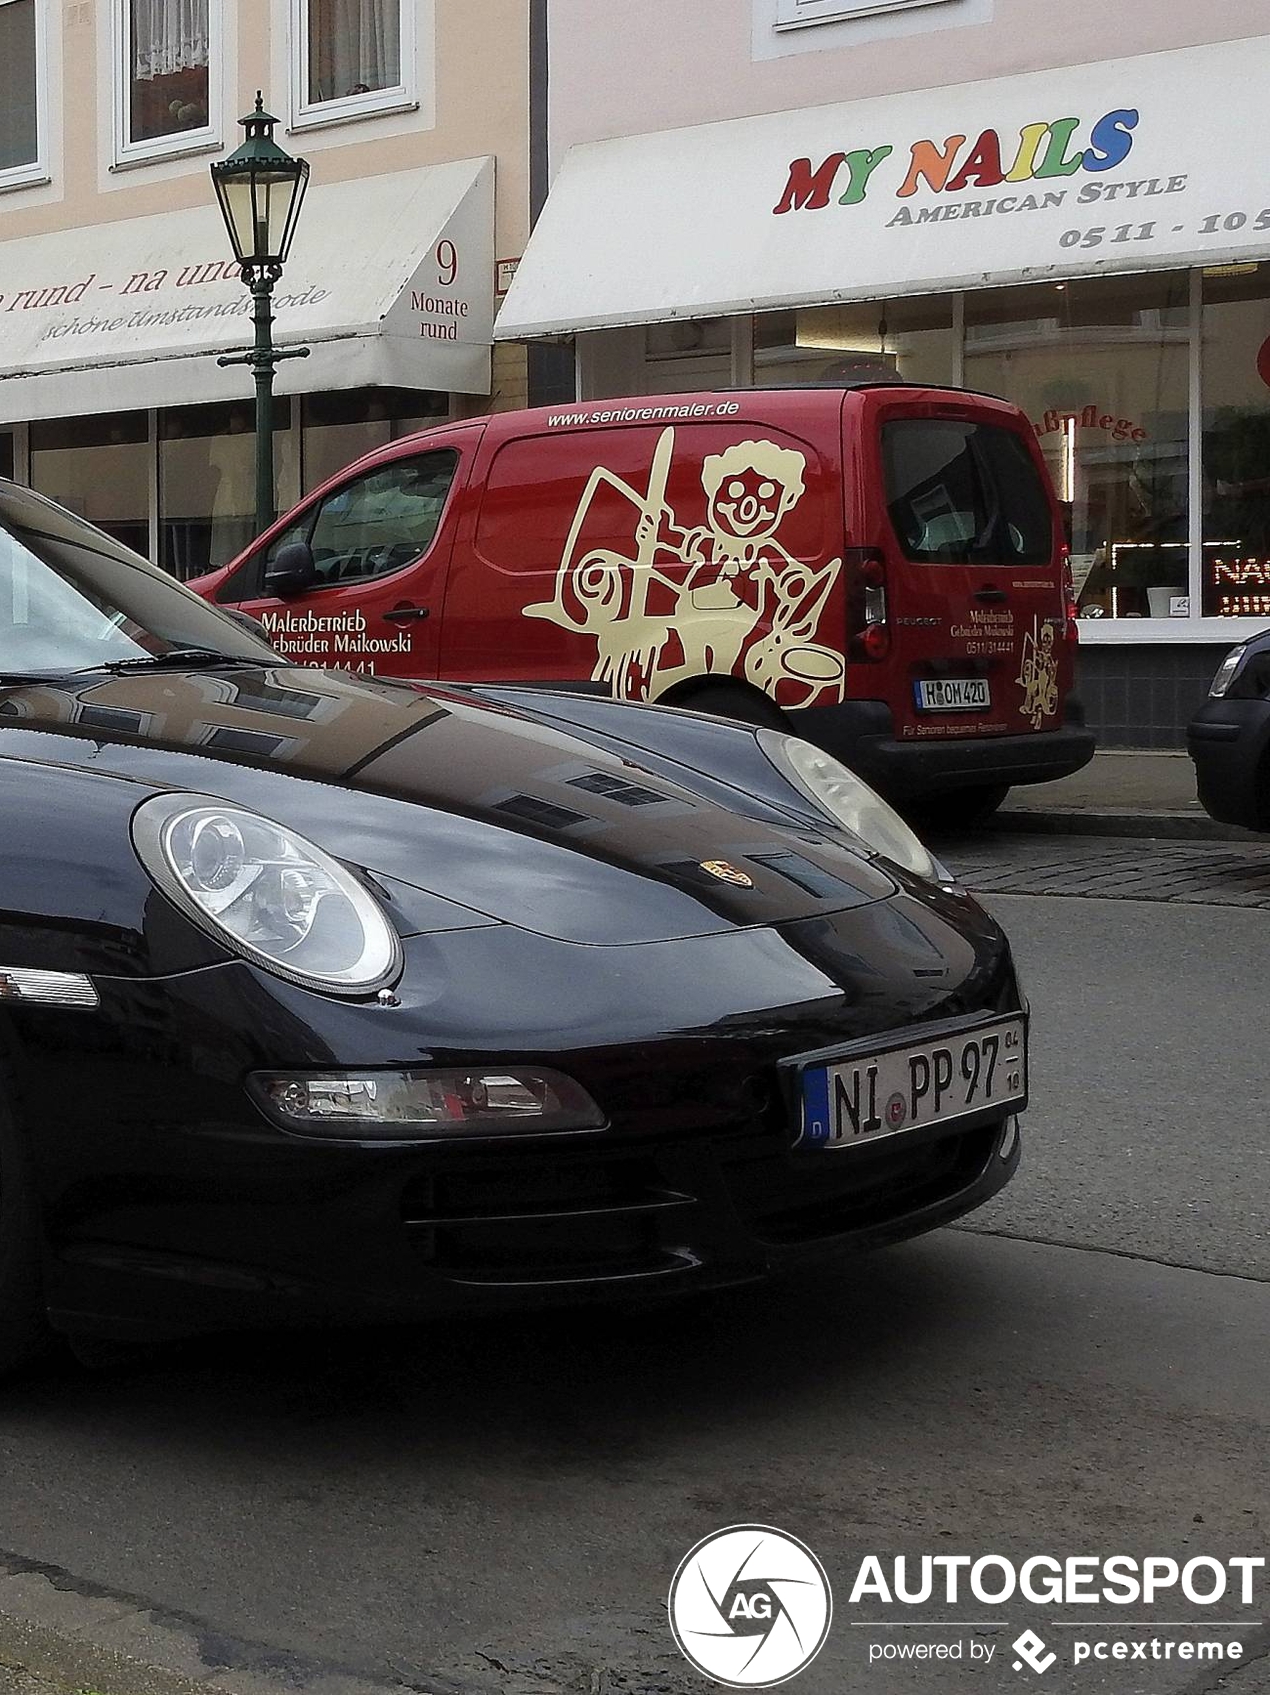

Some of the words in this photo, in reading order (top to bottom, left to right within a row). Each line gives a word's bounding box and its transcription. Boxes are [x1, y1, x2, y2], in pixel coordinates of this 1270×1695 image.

[772, 145, 893, 214] MY
[896, 108, 1140, 197] NAILS
[436, 239, 458, 286] 9
[5, 273, 96, 312] rund
[119, 269, 168, 295] na
[41, 314, 128, 341] schöne
[128, 284, 333, 328] Umstandsode
[411, 290, 469, 317] Monate
[420, 320, 458, 340] rund
[548, 401, 740, 427] www.seniorenmaler.de
[261, 608, 367, 633] Malerbetrieb
[896, 617, 943, 626] PEUGEOT
[273, 633, 329, 653] ebrüder
[334, 632, 411, 653] Maikowski
[926, 683, 936, 705] H
[944, 682, 962, 704] OM
[964, 681, 986, 703] 420
[834, 1066, 882, 1140] NI
[909, 1048, 953, 1120] PP
[961, 1034, 1000, 1104] 97
[1007, 1072, 1020, 1092] 10
[812, 1121, 822, 1139] D
